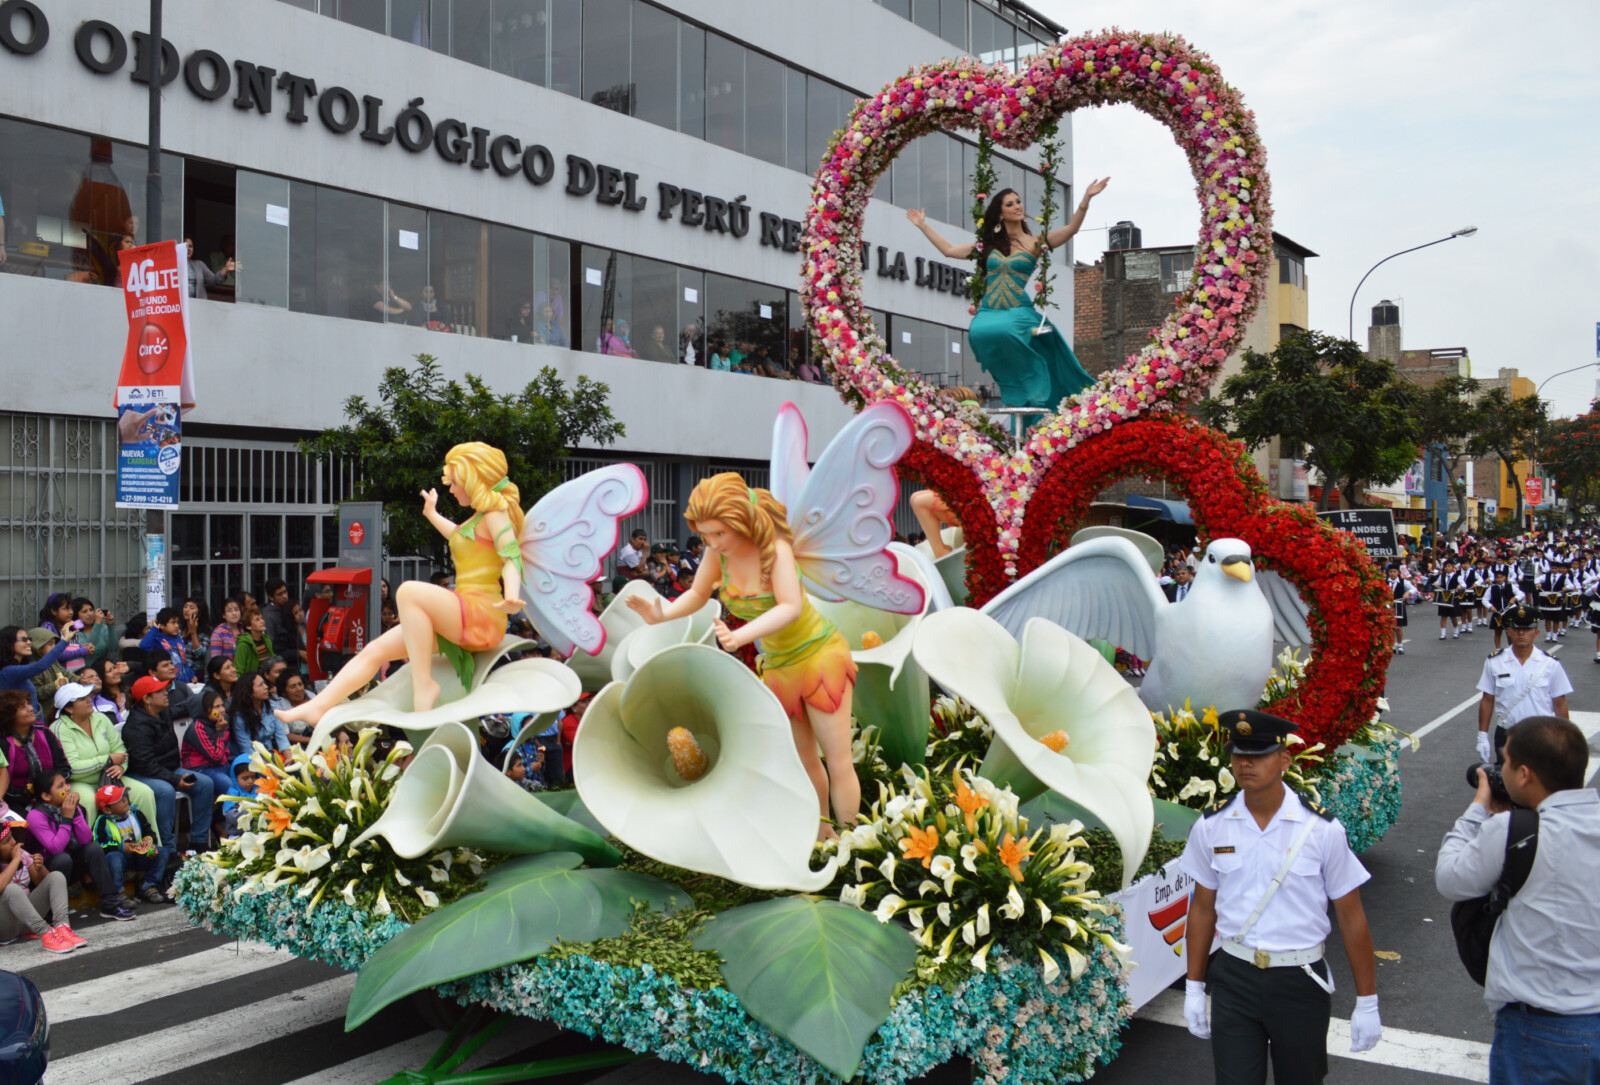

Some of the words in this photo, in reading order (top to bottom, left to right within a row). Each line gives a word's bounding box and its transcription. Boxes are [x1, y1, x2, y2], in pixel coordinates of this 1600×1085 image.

[75, 20, 555, 186] ODONTOLÓGICO
[566, 154, 647, 211] DEL
[658, 182, 751, 238] PERÚ
[877, 246, 909, 281] LA
[121, 449, 145, 458] NUEVAS
